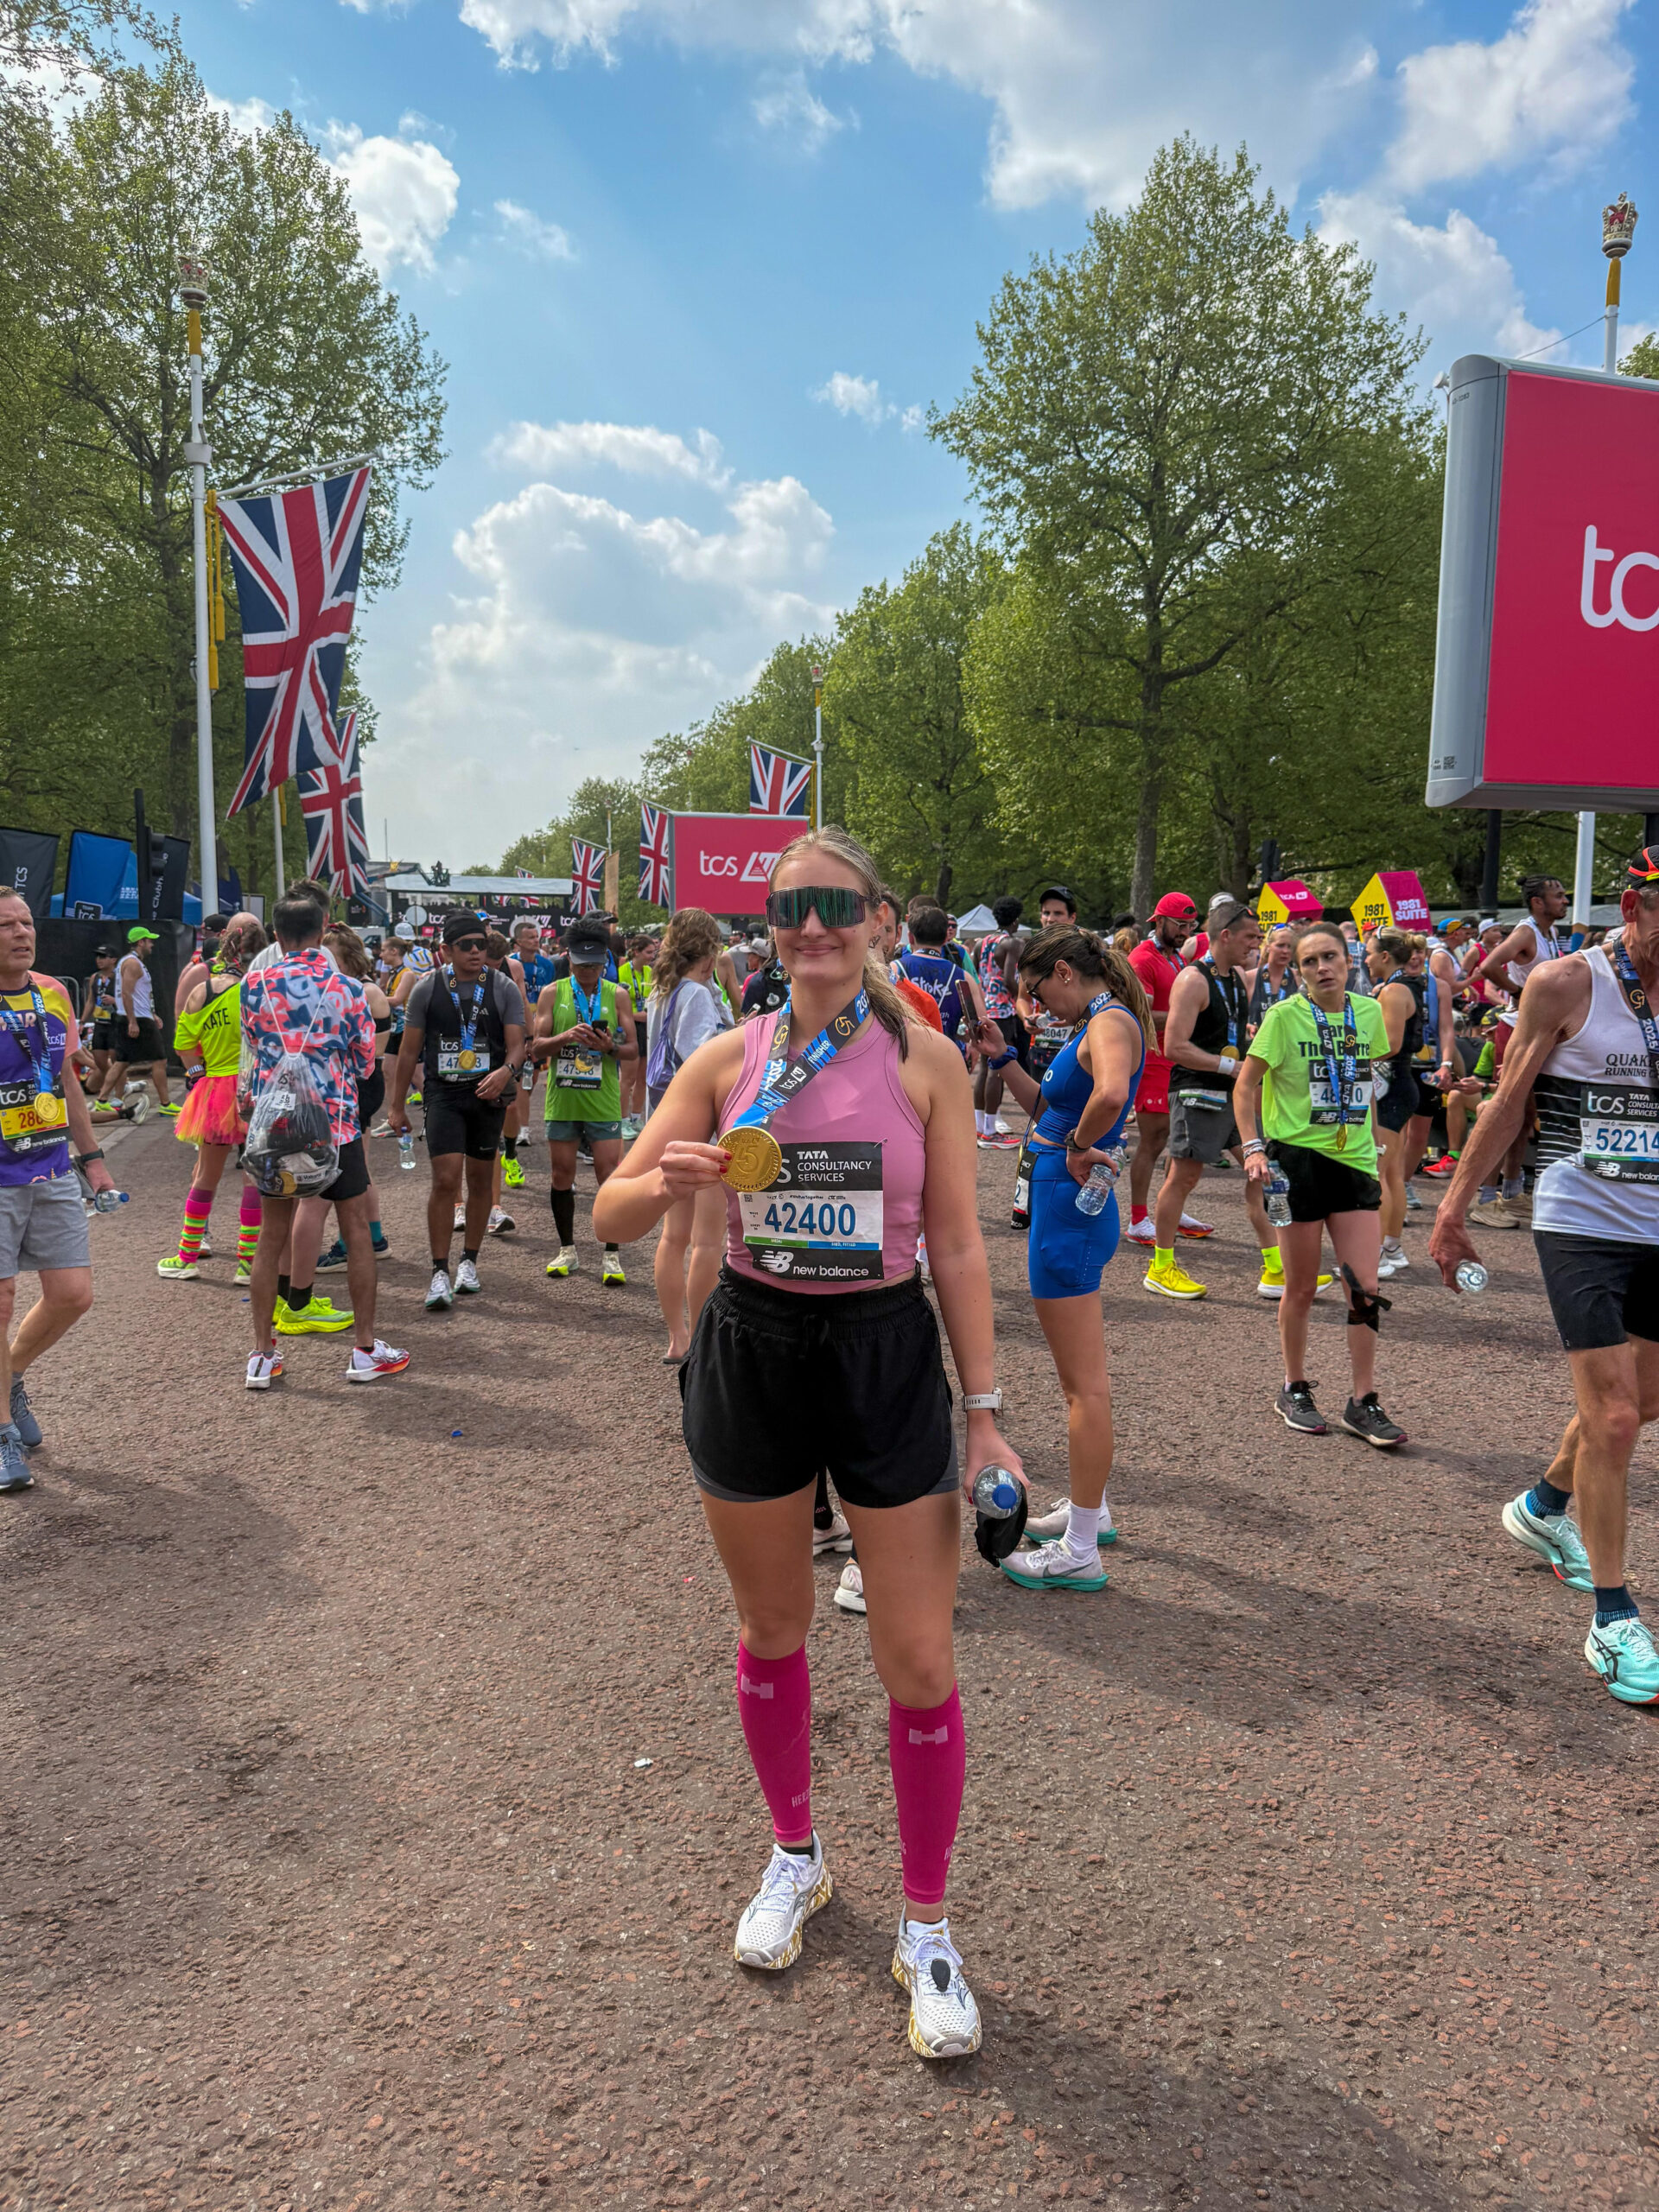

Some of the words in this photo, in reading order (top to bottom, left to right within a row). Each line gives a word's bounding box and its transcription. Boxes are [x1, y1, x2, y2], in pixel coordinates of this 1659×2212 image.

[700, 850, 738, 876] tcs
[15, 867, 28, 889] TCS
[1364, 904, 1384, 916] 1981
[1396, 899, 1421, 910] 1981
[1262, 911, 1277, 922] 1981
[1395, 908, 1427, 921] SUITE
[911, 976, 952, 997] Stroke
[1090, 991, 1112, 1011] 2025
[203, 1007, 231, 1031] KATE
[1643, 1018, 1658, 1050] 2025
[441, 1040, 459, 1051] tcs
[807, 1039, 832, 1065] FINISHER
[561, 1048, 574, 1058] tcs
[1314, 1063, 1329, 1078] tc
[1605, 1068, 1647, 1077] RUNNING
[0, 1089, 27, 1105] tcs
[1587, 1091, 1624, 1115] tcs
[1626, 1109, 1657, 1117] SERVICES
[43, 1135, 67, 1145] balance
[1596, 1128, 1659, 1153] 52214
[797, 1150, 829, 1160] TATA
[797, 1160, 872, 1172] CONSULTANCY
[798, 1173, 845, 1183] SERVICES
[764, 1202, 856, 1236] 42400
[792, 1265, 817, 1276] new
[819, 1265, 869, 1277] balance
